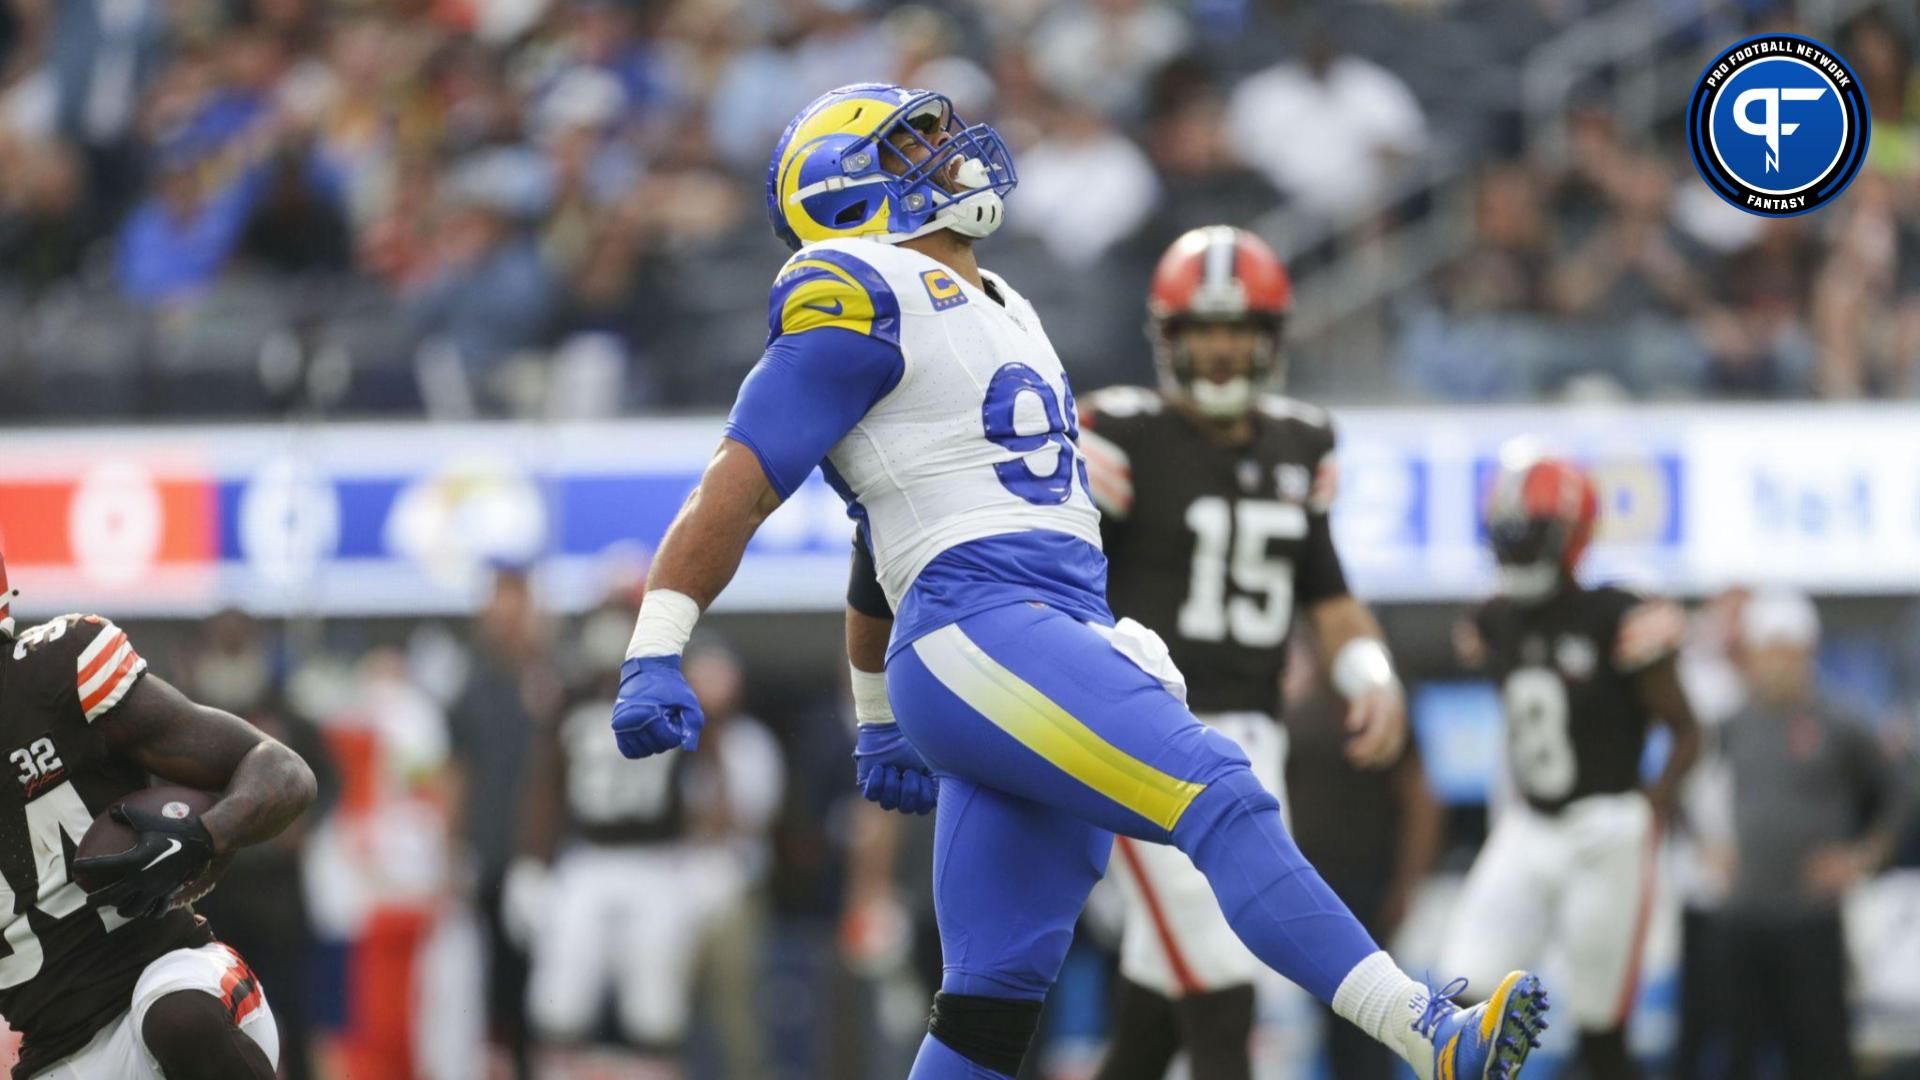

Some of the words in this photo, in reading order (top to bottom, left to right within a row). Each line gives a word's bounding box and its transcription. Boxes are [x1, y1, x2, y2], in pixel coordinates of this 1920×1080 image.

[924, 270, 960, 299] C
[1178, 496, 1307, 648] 15
[9, 737, 64, 785] 32
